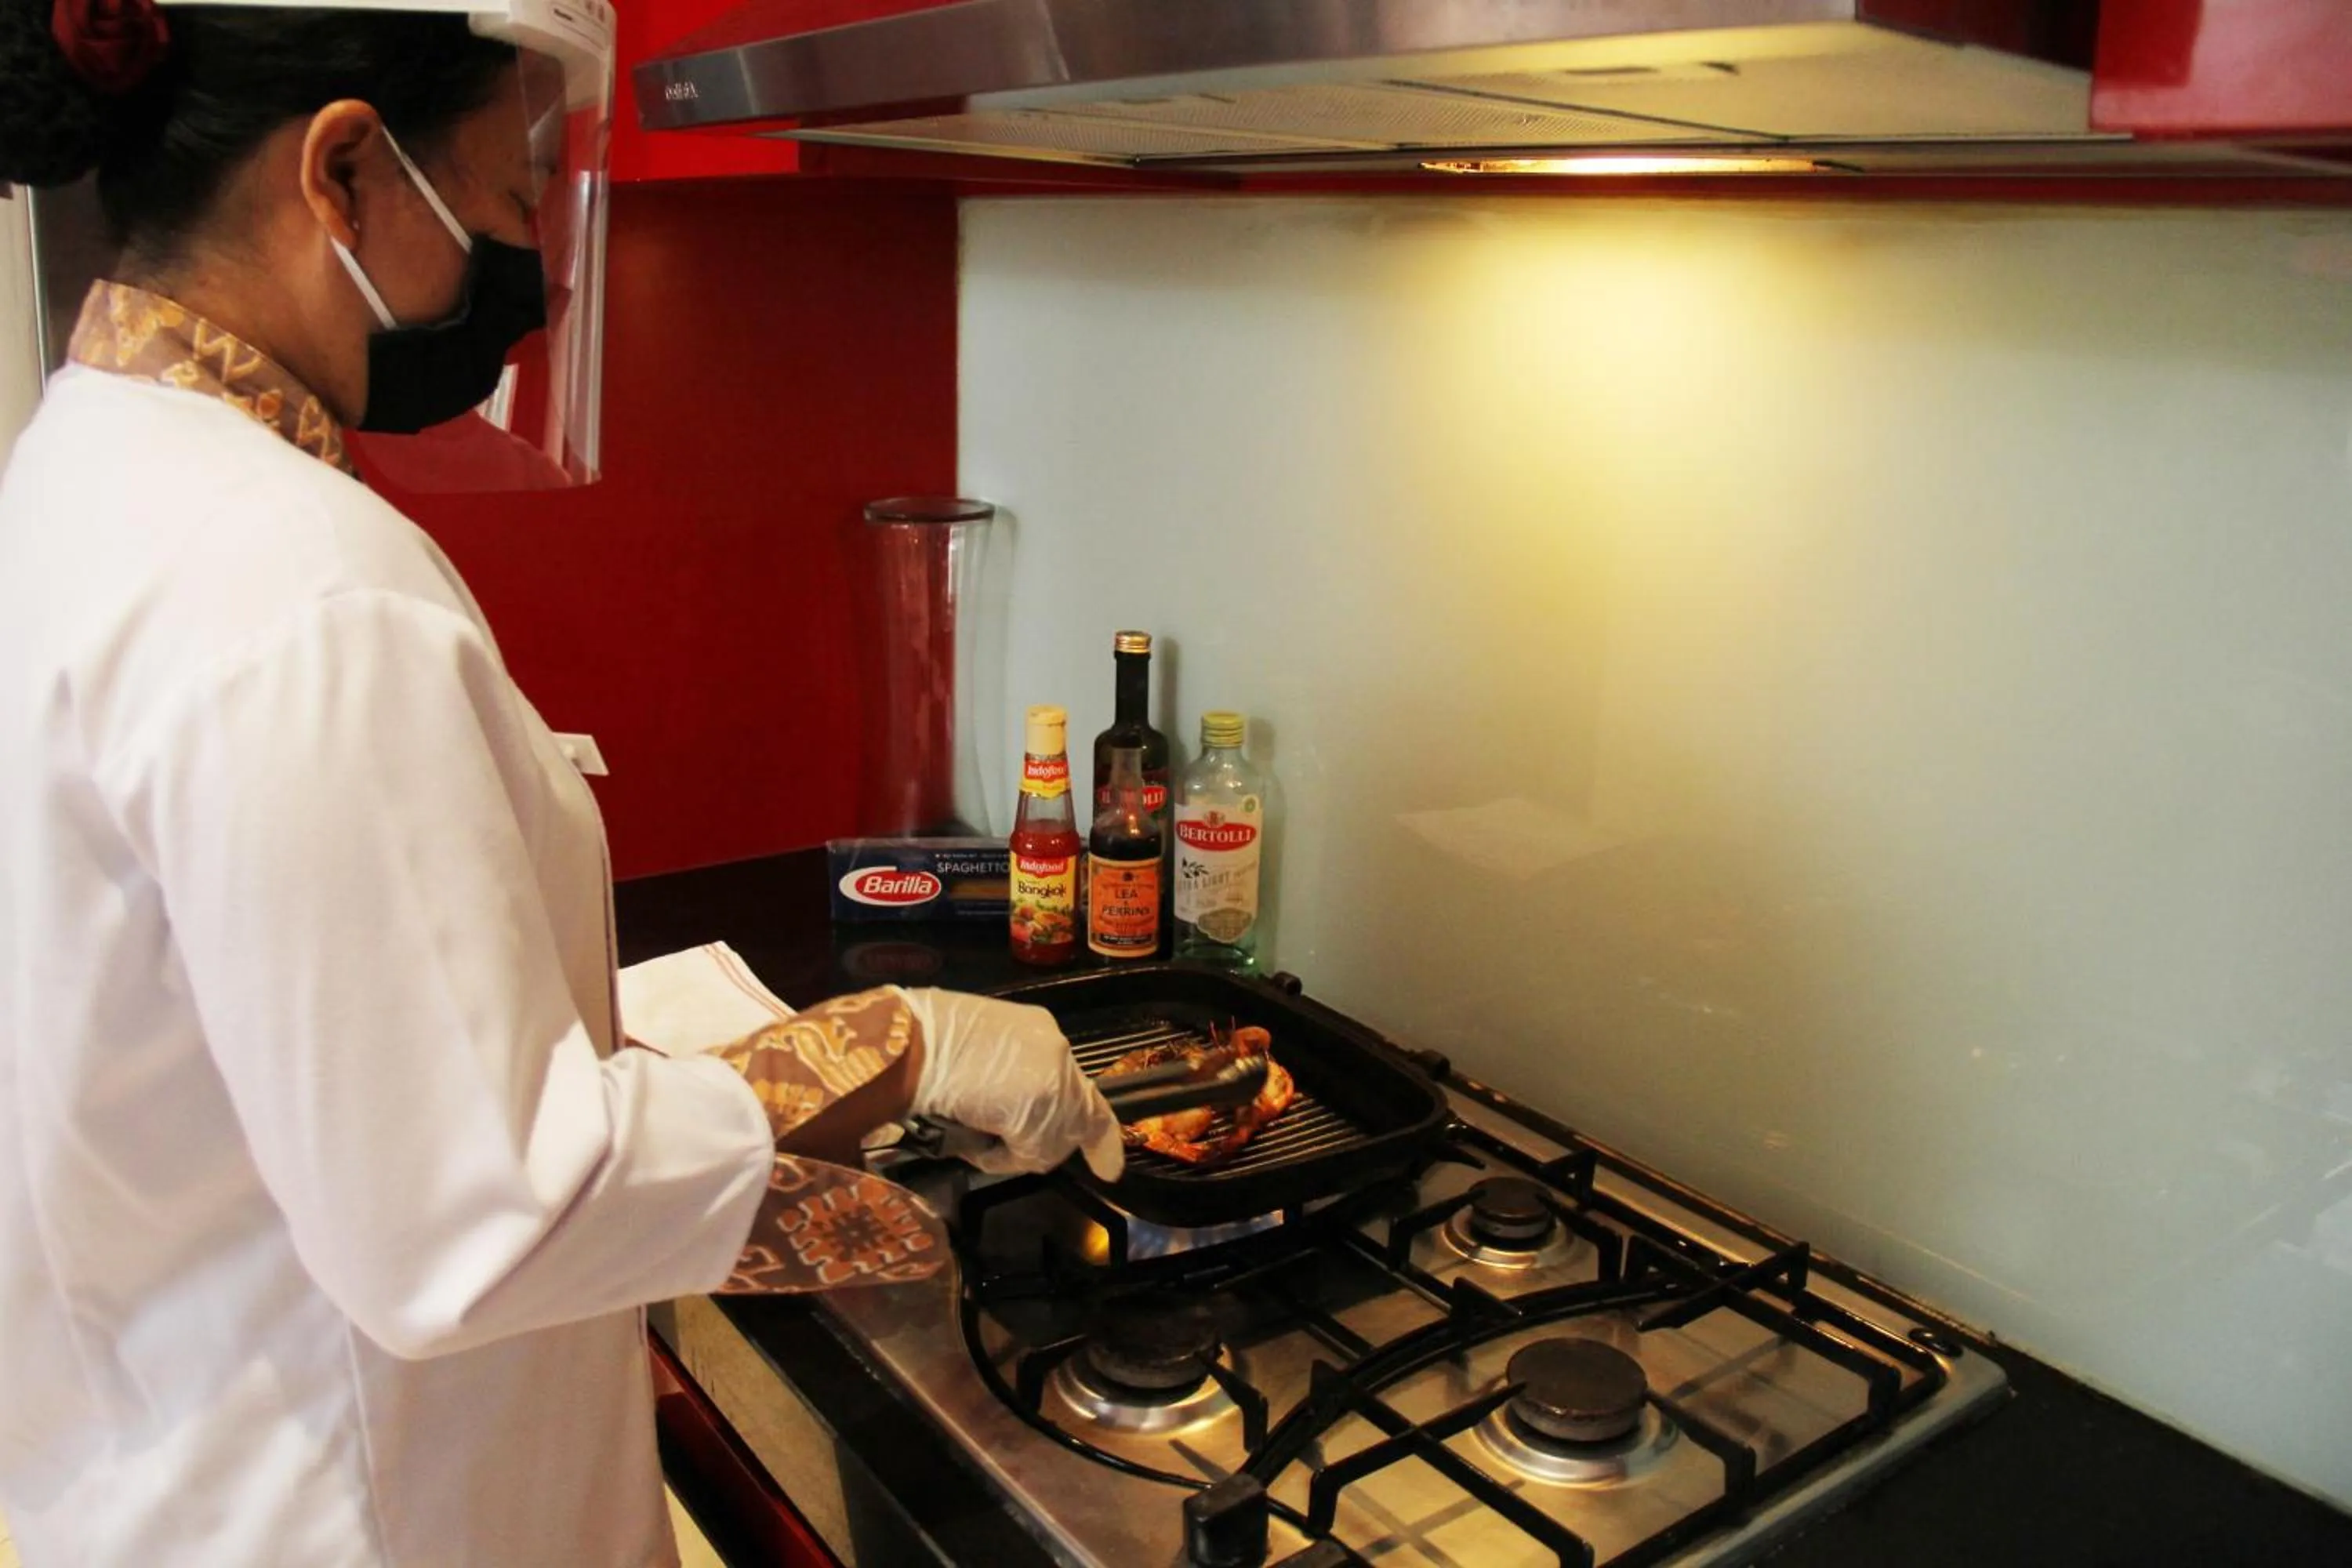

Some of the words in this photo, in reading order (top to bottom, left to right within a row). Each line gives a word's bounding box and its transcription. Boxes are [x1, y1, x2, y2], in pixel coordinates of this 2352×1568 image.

[1179, 824, 1251, 843] BERTOLLI
[1020, 859, 1064, 875] Indofood
[863, 876, 933, 895] Barilla
[1018, 880, 1066, 898] Bangkok
[1115, 887, 1138, 899] LEA
